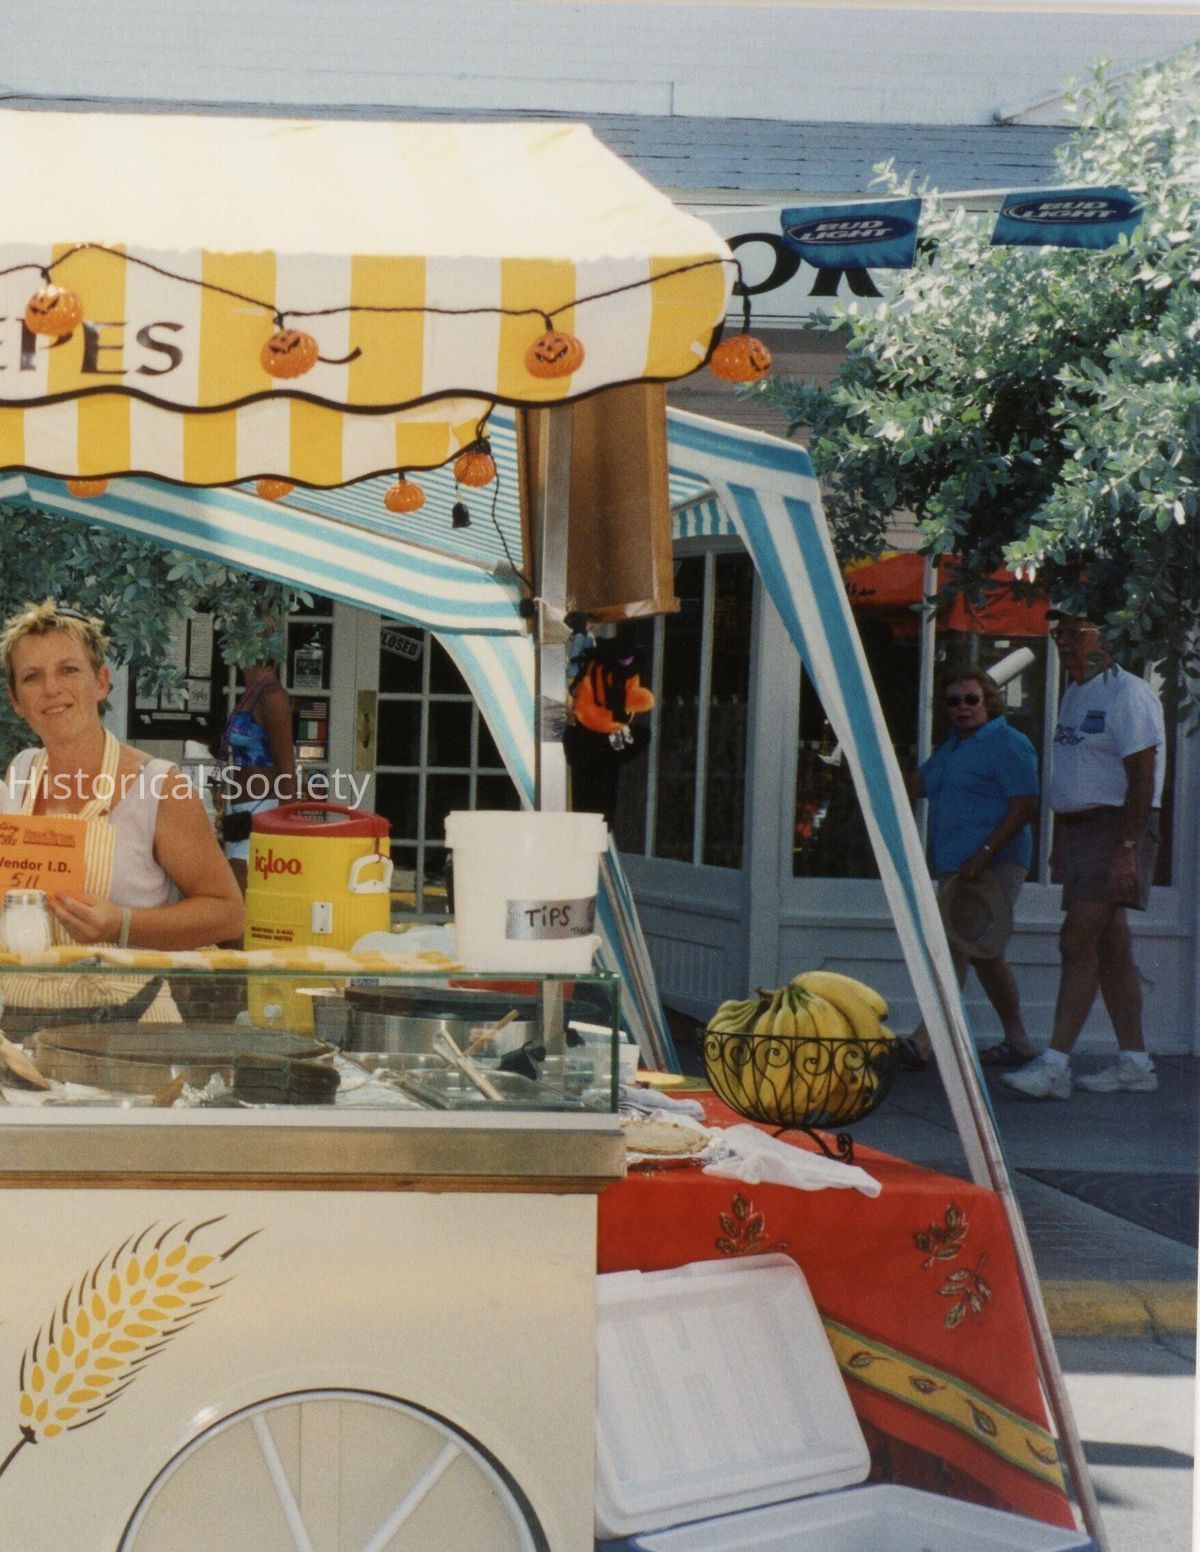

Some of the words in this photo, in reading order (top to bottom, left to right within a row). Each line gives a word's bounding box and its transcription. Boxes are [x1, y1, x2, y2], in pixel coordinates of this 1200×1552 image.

[1039, 202, 1108, 211] BUD
[1022, 209, 1118, 218] LIGHT
[815, 220, 885, 232] BUD
[800, 228, 893, 241] LIGHT
[380, 631, 418, 656] LOSED
[48, 862, 71, 873] I.D.
[255, 848, 301, 880] igloo
